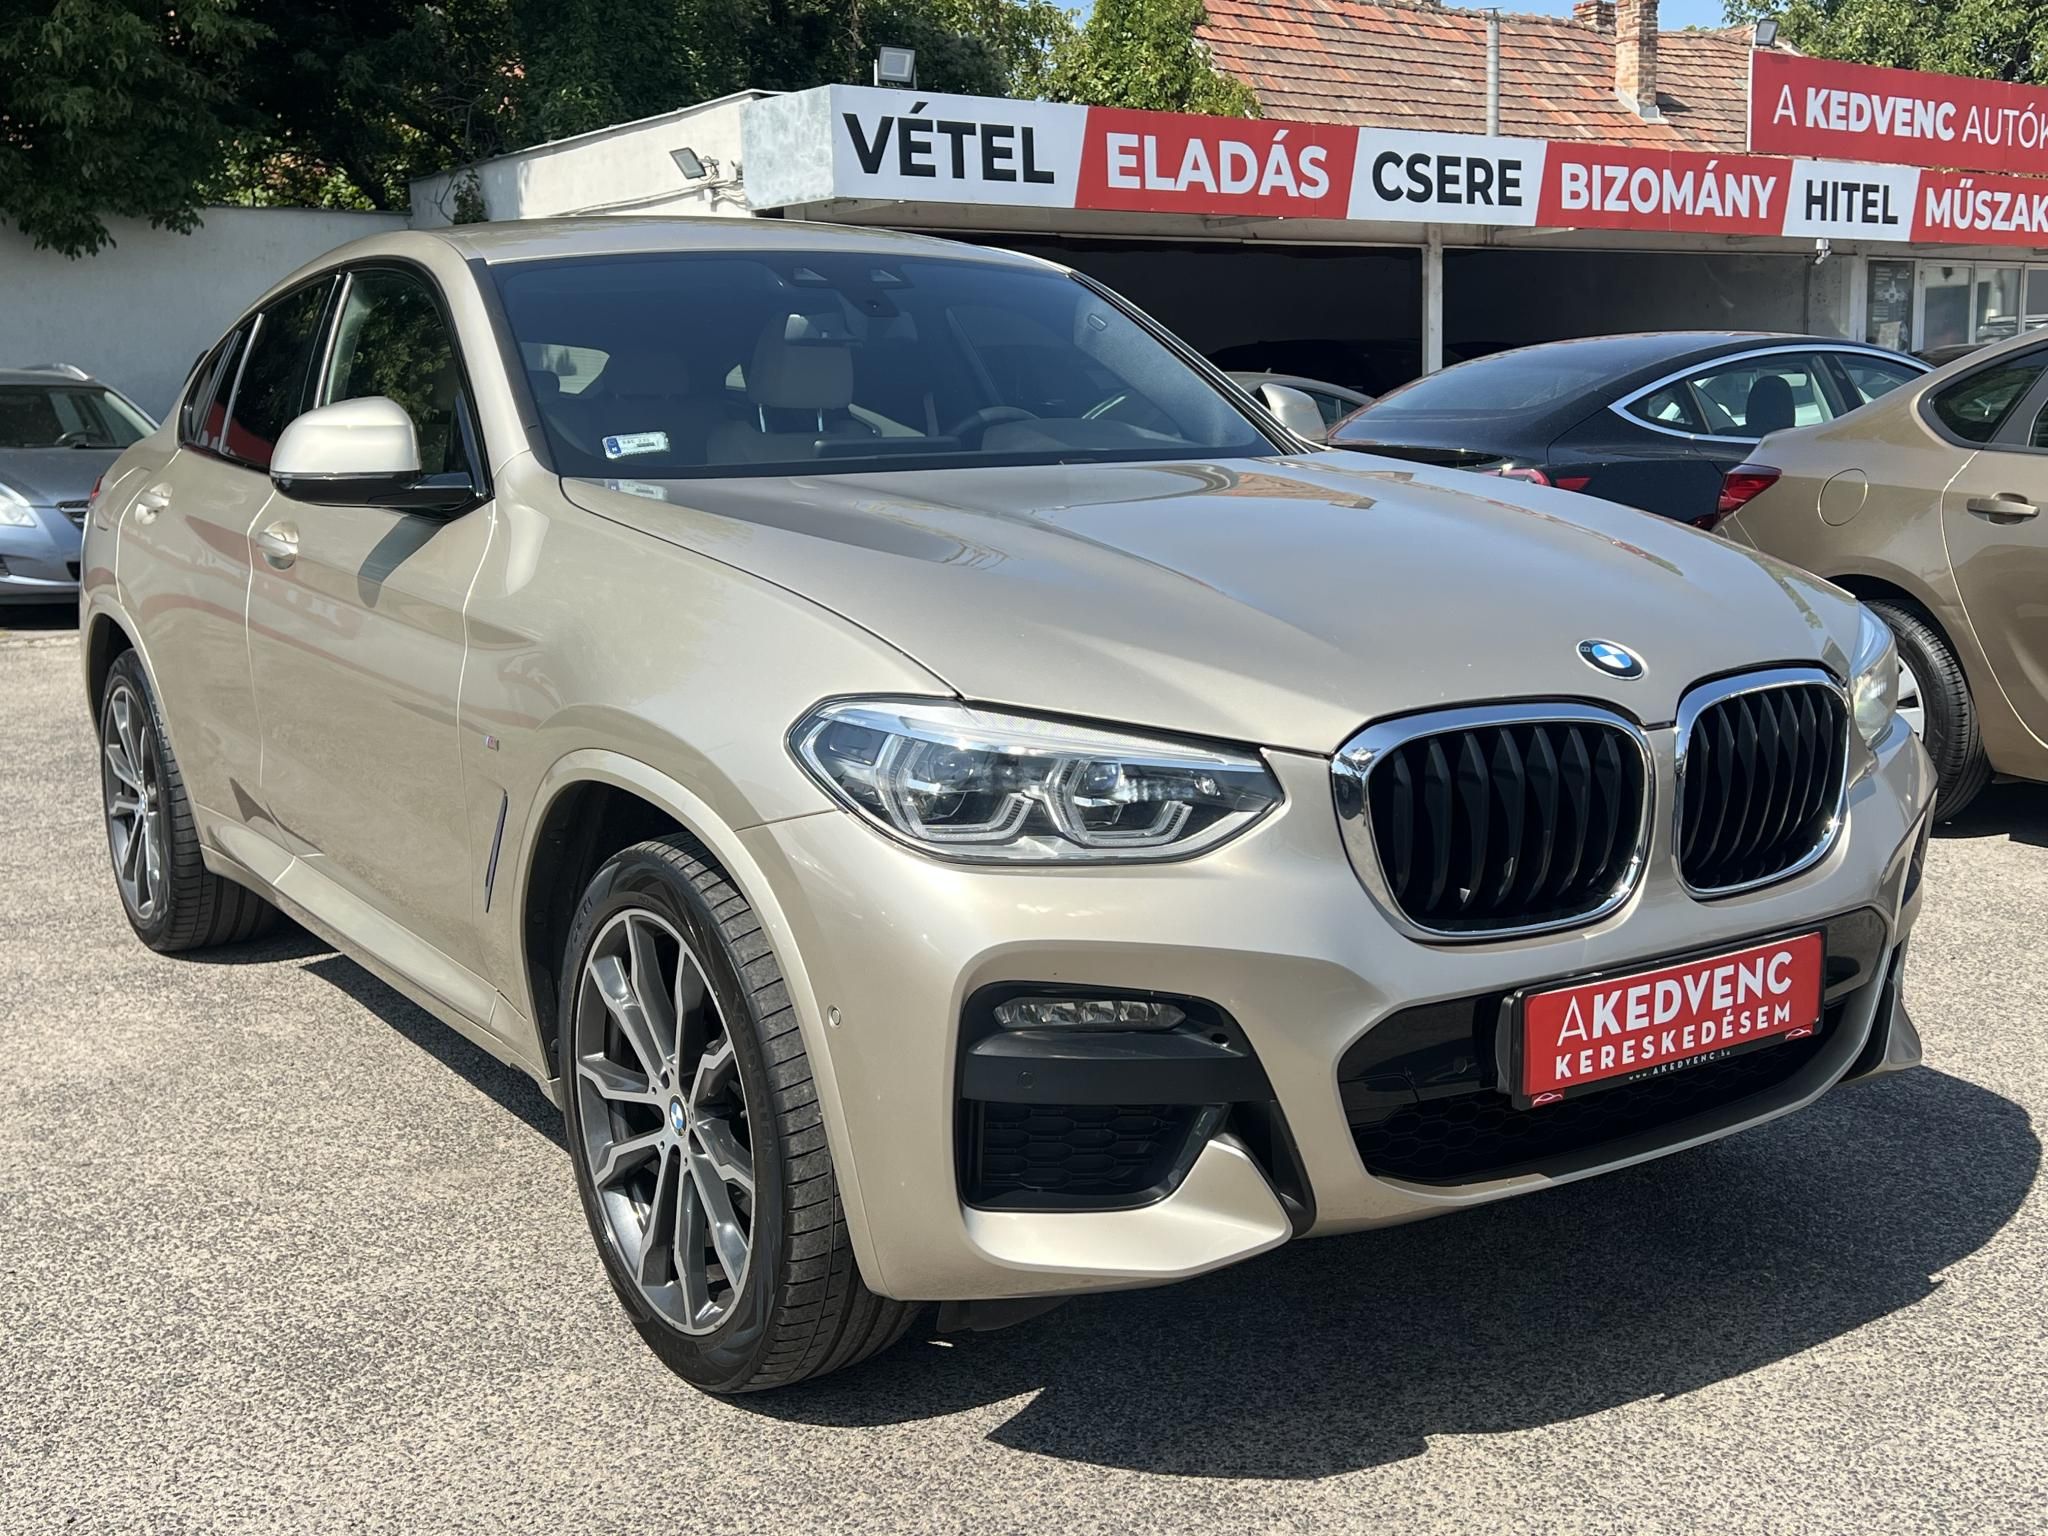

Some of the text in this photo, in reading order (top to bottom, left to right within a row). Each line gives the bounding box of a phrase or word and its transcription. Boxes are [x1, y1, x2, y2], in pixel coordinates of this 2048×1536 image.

[1773, 84, 1796, 126] A
[1806, 88, 1957, 142] KEDVENC
[843, 101, 1055, 184] VÉTEL
[1105, 129, 1329, 199] ELADÁS
[1372, 151, 1523, 206] CSERE
[1560, 160, 1777, 219] BIZOMÁNY
[1805, 179, 1899, 225] HITEL
[1925, 178, 2048, 233] MŰSZAK
[1555, 1000, 1791, 1080] KERESKEDÉSEM
